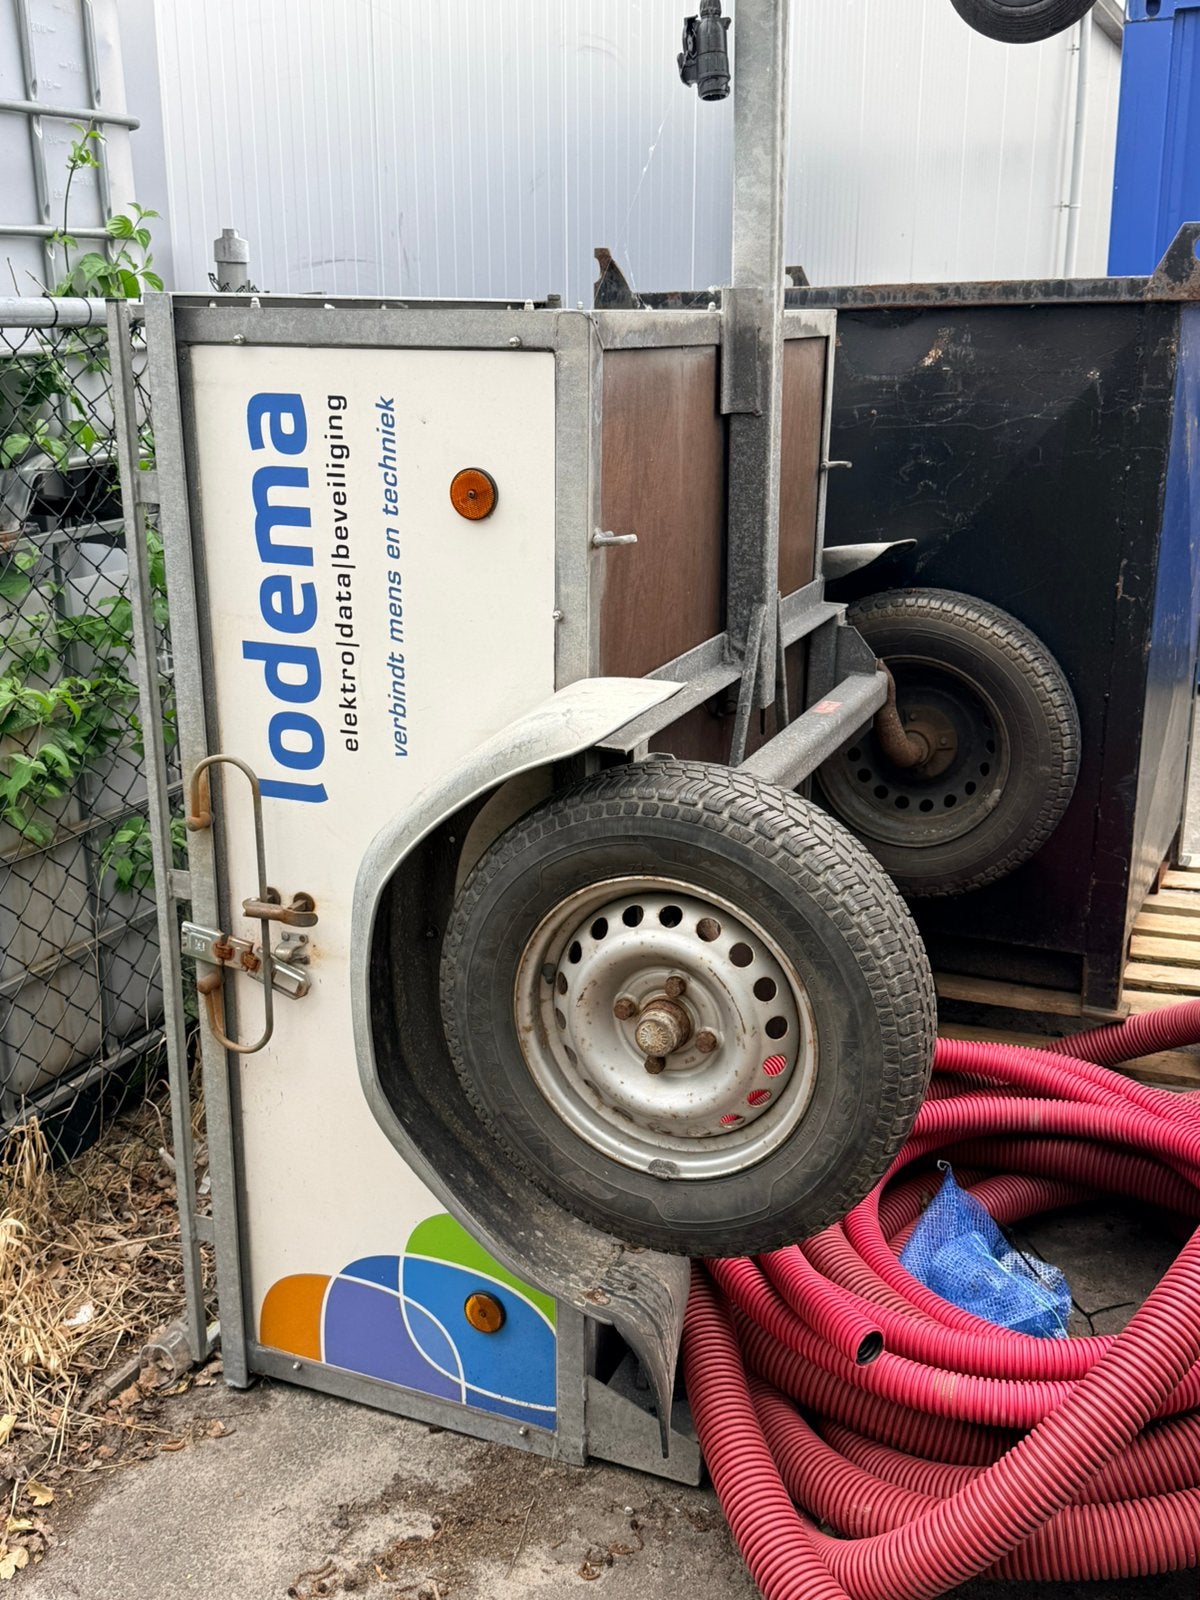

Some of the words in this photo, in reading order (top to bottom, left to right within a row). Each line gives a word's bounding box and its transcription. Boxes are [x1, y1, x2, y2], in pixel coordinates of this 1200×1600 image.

[375, 395, 400, 517] techniek
[386, 526, 401, 560] en
[242, 392, 329, 804] lodema
[387, 570, 405, 643] mens
[388, 652, 408, 757] verbindt
